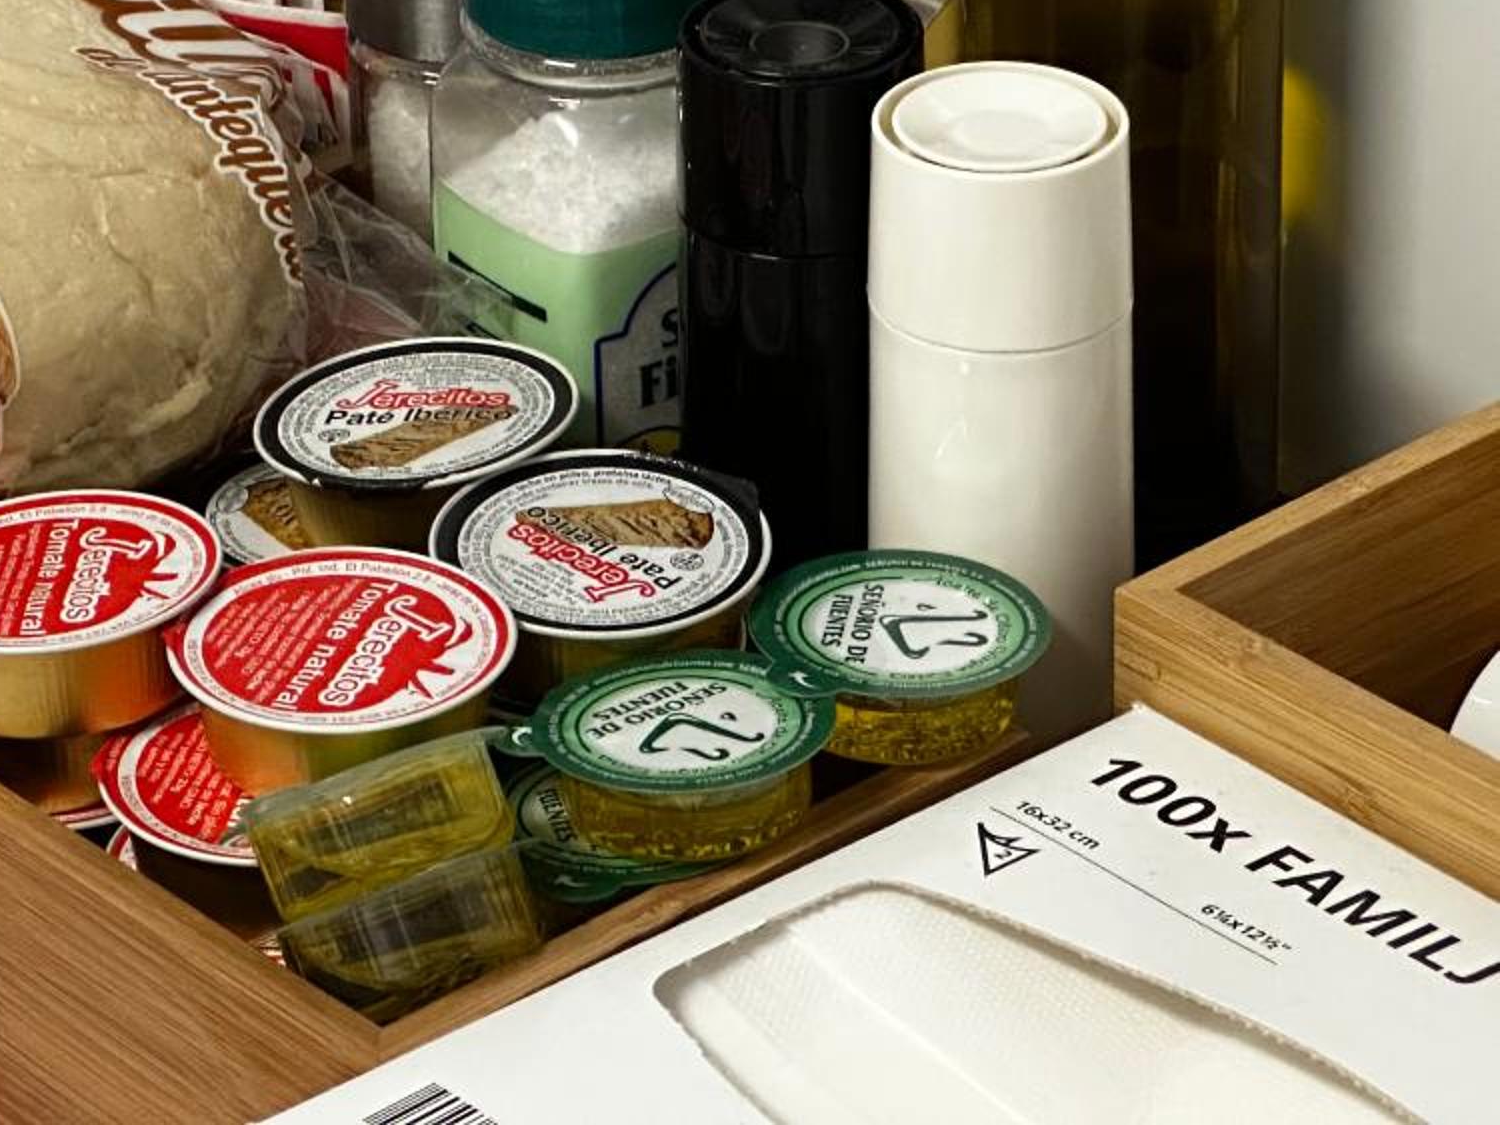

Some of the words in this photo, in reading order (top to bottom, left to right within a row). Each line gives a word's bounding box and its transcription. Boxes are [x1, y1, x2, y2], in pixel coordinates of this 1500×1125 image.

[335, 379, 514, 411] Jerecitos
[36, 517, 80, 586] Tomate
[58, 525, 154, 624] Jerecitos
[504, 520, 657, 605] Jerecitos
[18, 583, 54, 637] natural
[324, 580, 399, 642] Tomate
[820, 593, 855, 649] FUENTES
[318, 594, 453, 706] Jerecitos
[845, 644, 869, 666] DE
[269, 645, 335, 712] natural
[591, 680, 690, 721] FUENTES
[585, 721, 622, 742] DE
[1016, 800, 1072, 834] 16x32
[1067, 829, 1101, 851] cm
